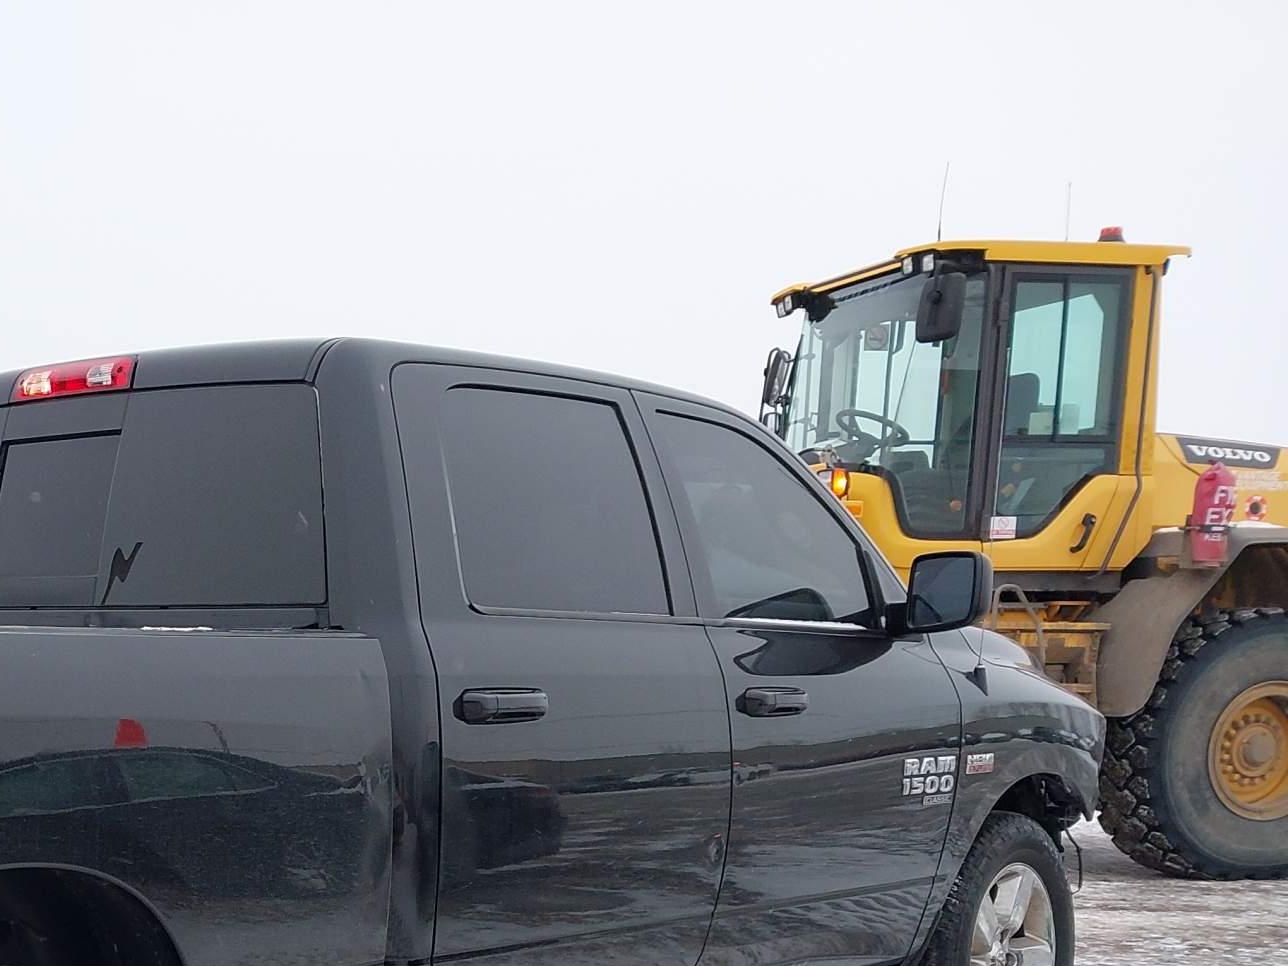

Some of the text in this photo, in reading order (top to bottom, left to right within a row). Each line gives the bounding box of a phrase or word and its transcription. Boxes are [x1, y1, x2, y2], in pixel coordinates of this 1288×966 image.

[1185, 444, 1272, 463] VOLVO
[904, 755, 956, 777] RAM
[903, 775, 954, 795] 1500
